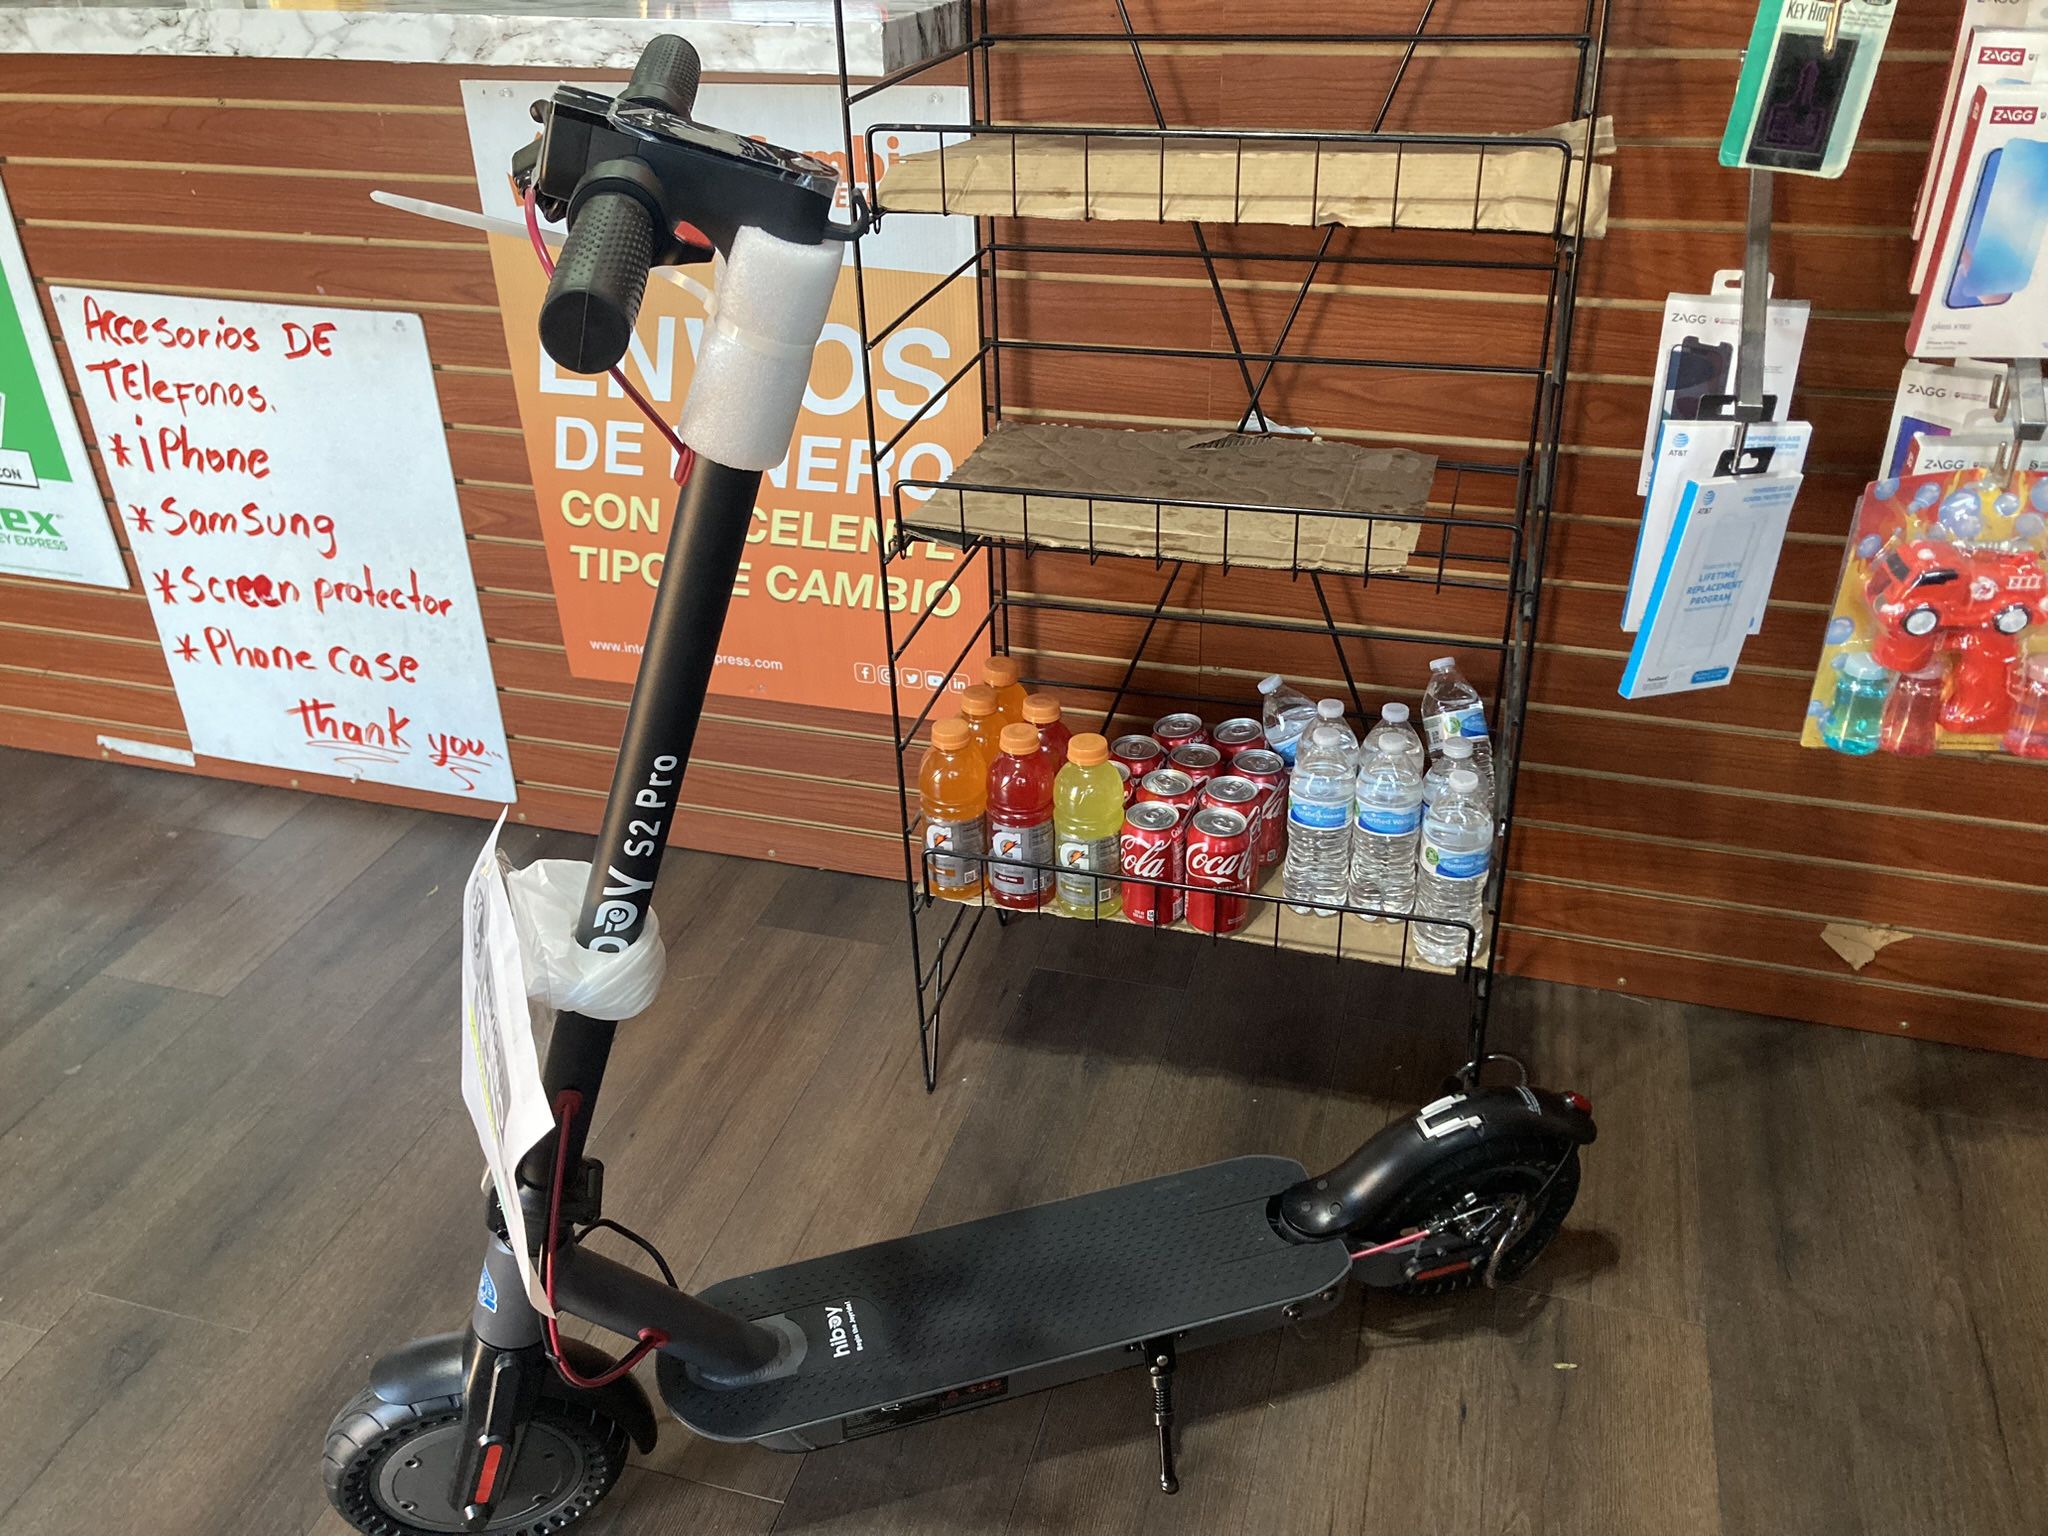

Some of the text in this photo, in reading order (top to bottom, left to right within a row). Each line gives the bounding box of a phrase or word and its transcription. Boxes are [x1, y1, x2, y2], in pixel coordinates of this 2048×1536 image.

[1981, 49, 2022, 63] ZAGG
[1993, 108, 2034, 122] ZAGG
[1671, 312, 1707, 325] ZAGG
[281, 321, 338, 360] DE
[1906, 383, 1947, 399] ZAGG
[554, 415, 646, 477] DE
[1668, 449, 1688, 457] AT&T
[1924, 458, 1966, 470] ZAGG
[560, 489, 660, 534] CON
[14, 535, 68, 552] EXPRESS
[1686, 580, 1744, 595] REPLACEMENT
[1698, 569, 1737, 583] LIFETIME
[314, 563, 453, 617] protector
[765, 562, 963, 619] CAMBIO
[1689, 592, 1732, 606] PROGRAM
[204, 625, 318, 671] Phone
[635, 754, 678, 809] Pro
[622, 818, 662, 857] S2
[1060, 842, 1090, 871] G
[824, 1306, 851, 1359] hiboy
